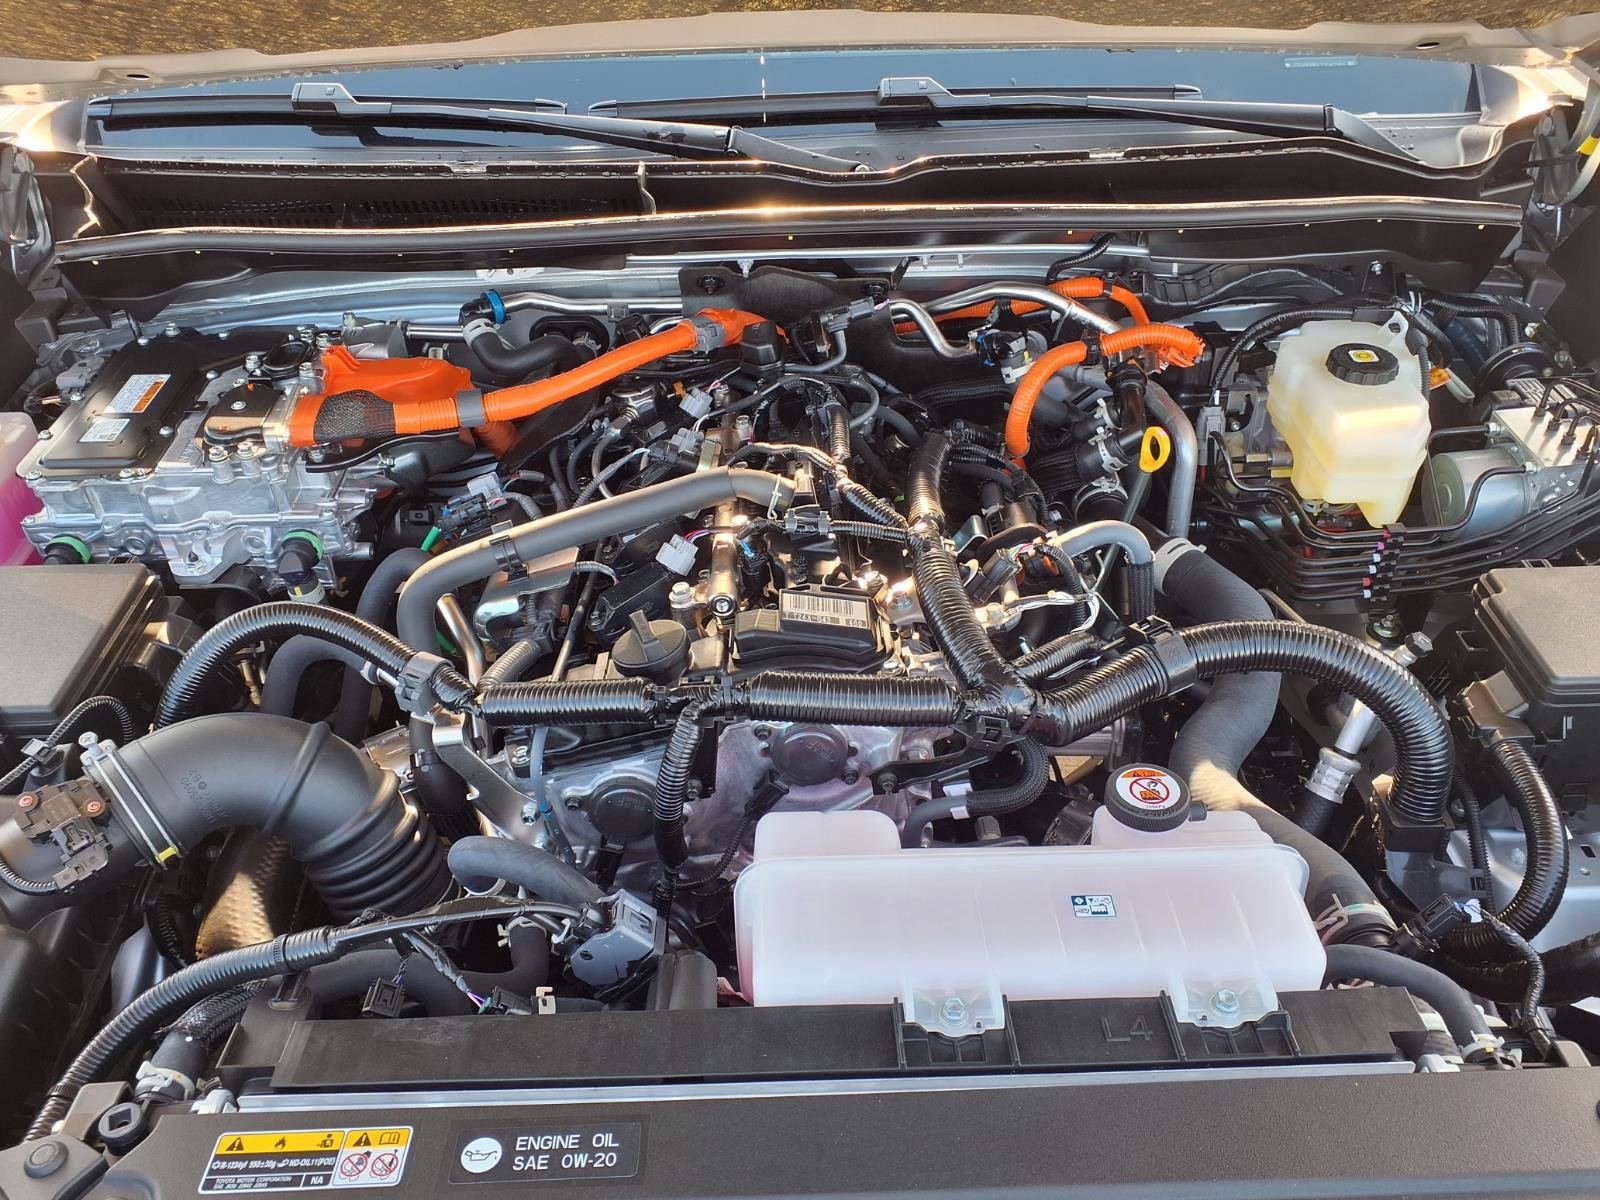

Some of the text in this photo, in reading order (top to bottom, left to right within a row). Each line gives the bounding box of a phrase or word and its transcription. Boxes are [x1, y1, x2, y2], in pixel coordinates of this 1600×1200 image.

[1101, 1015, 1153, 1042] L4
[515, 1133, 620, 1151] ENGINE OIL
[512, 1152, 617, 1171] SAE 0W-20
[310, 1175, 324, 1185] NA
